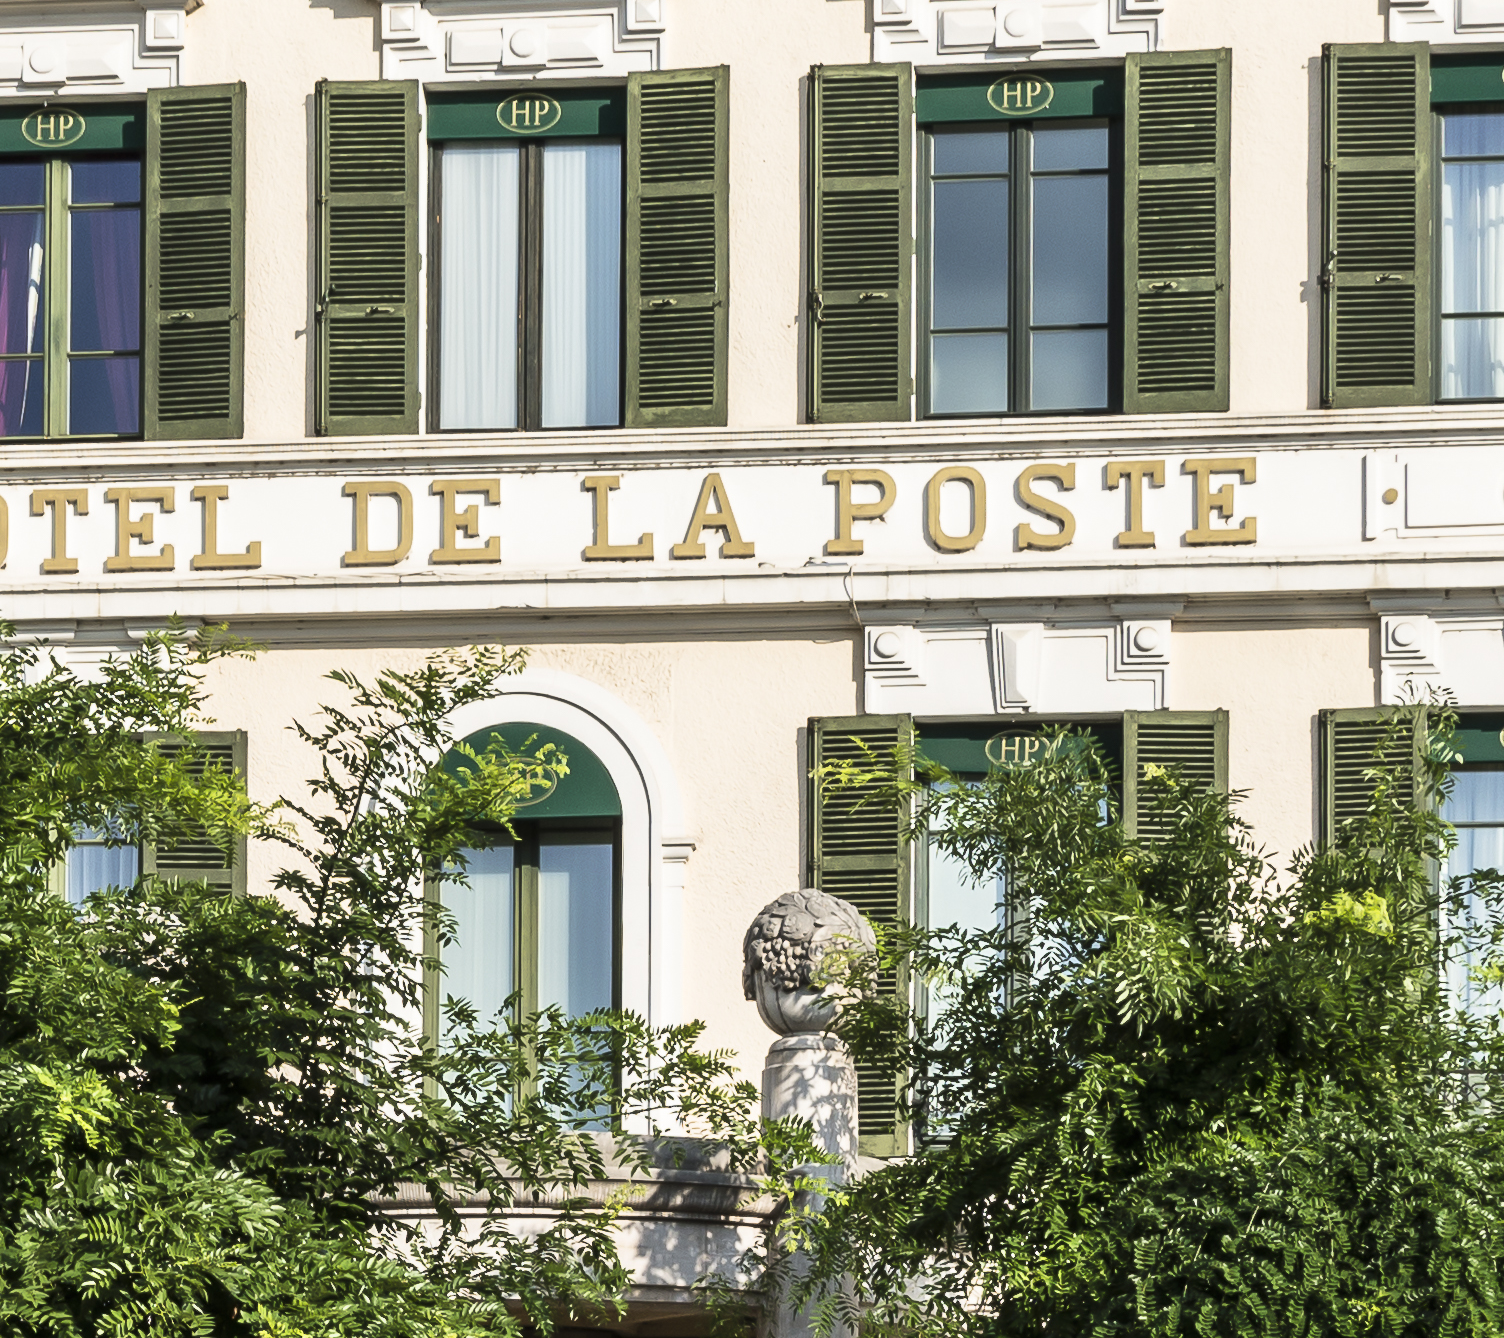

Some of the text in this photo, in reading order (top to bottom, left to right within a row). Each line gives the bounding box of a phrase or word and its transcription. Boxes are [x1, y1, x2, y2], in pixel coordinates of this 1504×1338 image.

[1001, 81, 1042, 108] HP
[510, 99, 550, 126] HP
[36, 114, 74, 140] HP
[341, 478, 502, 568] DE
[581, 472, 755, 562] LA
[822, 457, 1258, 557] POSTE
[1000, 736, 1040, 765] HP
